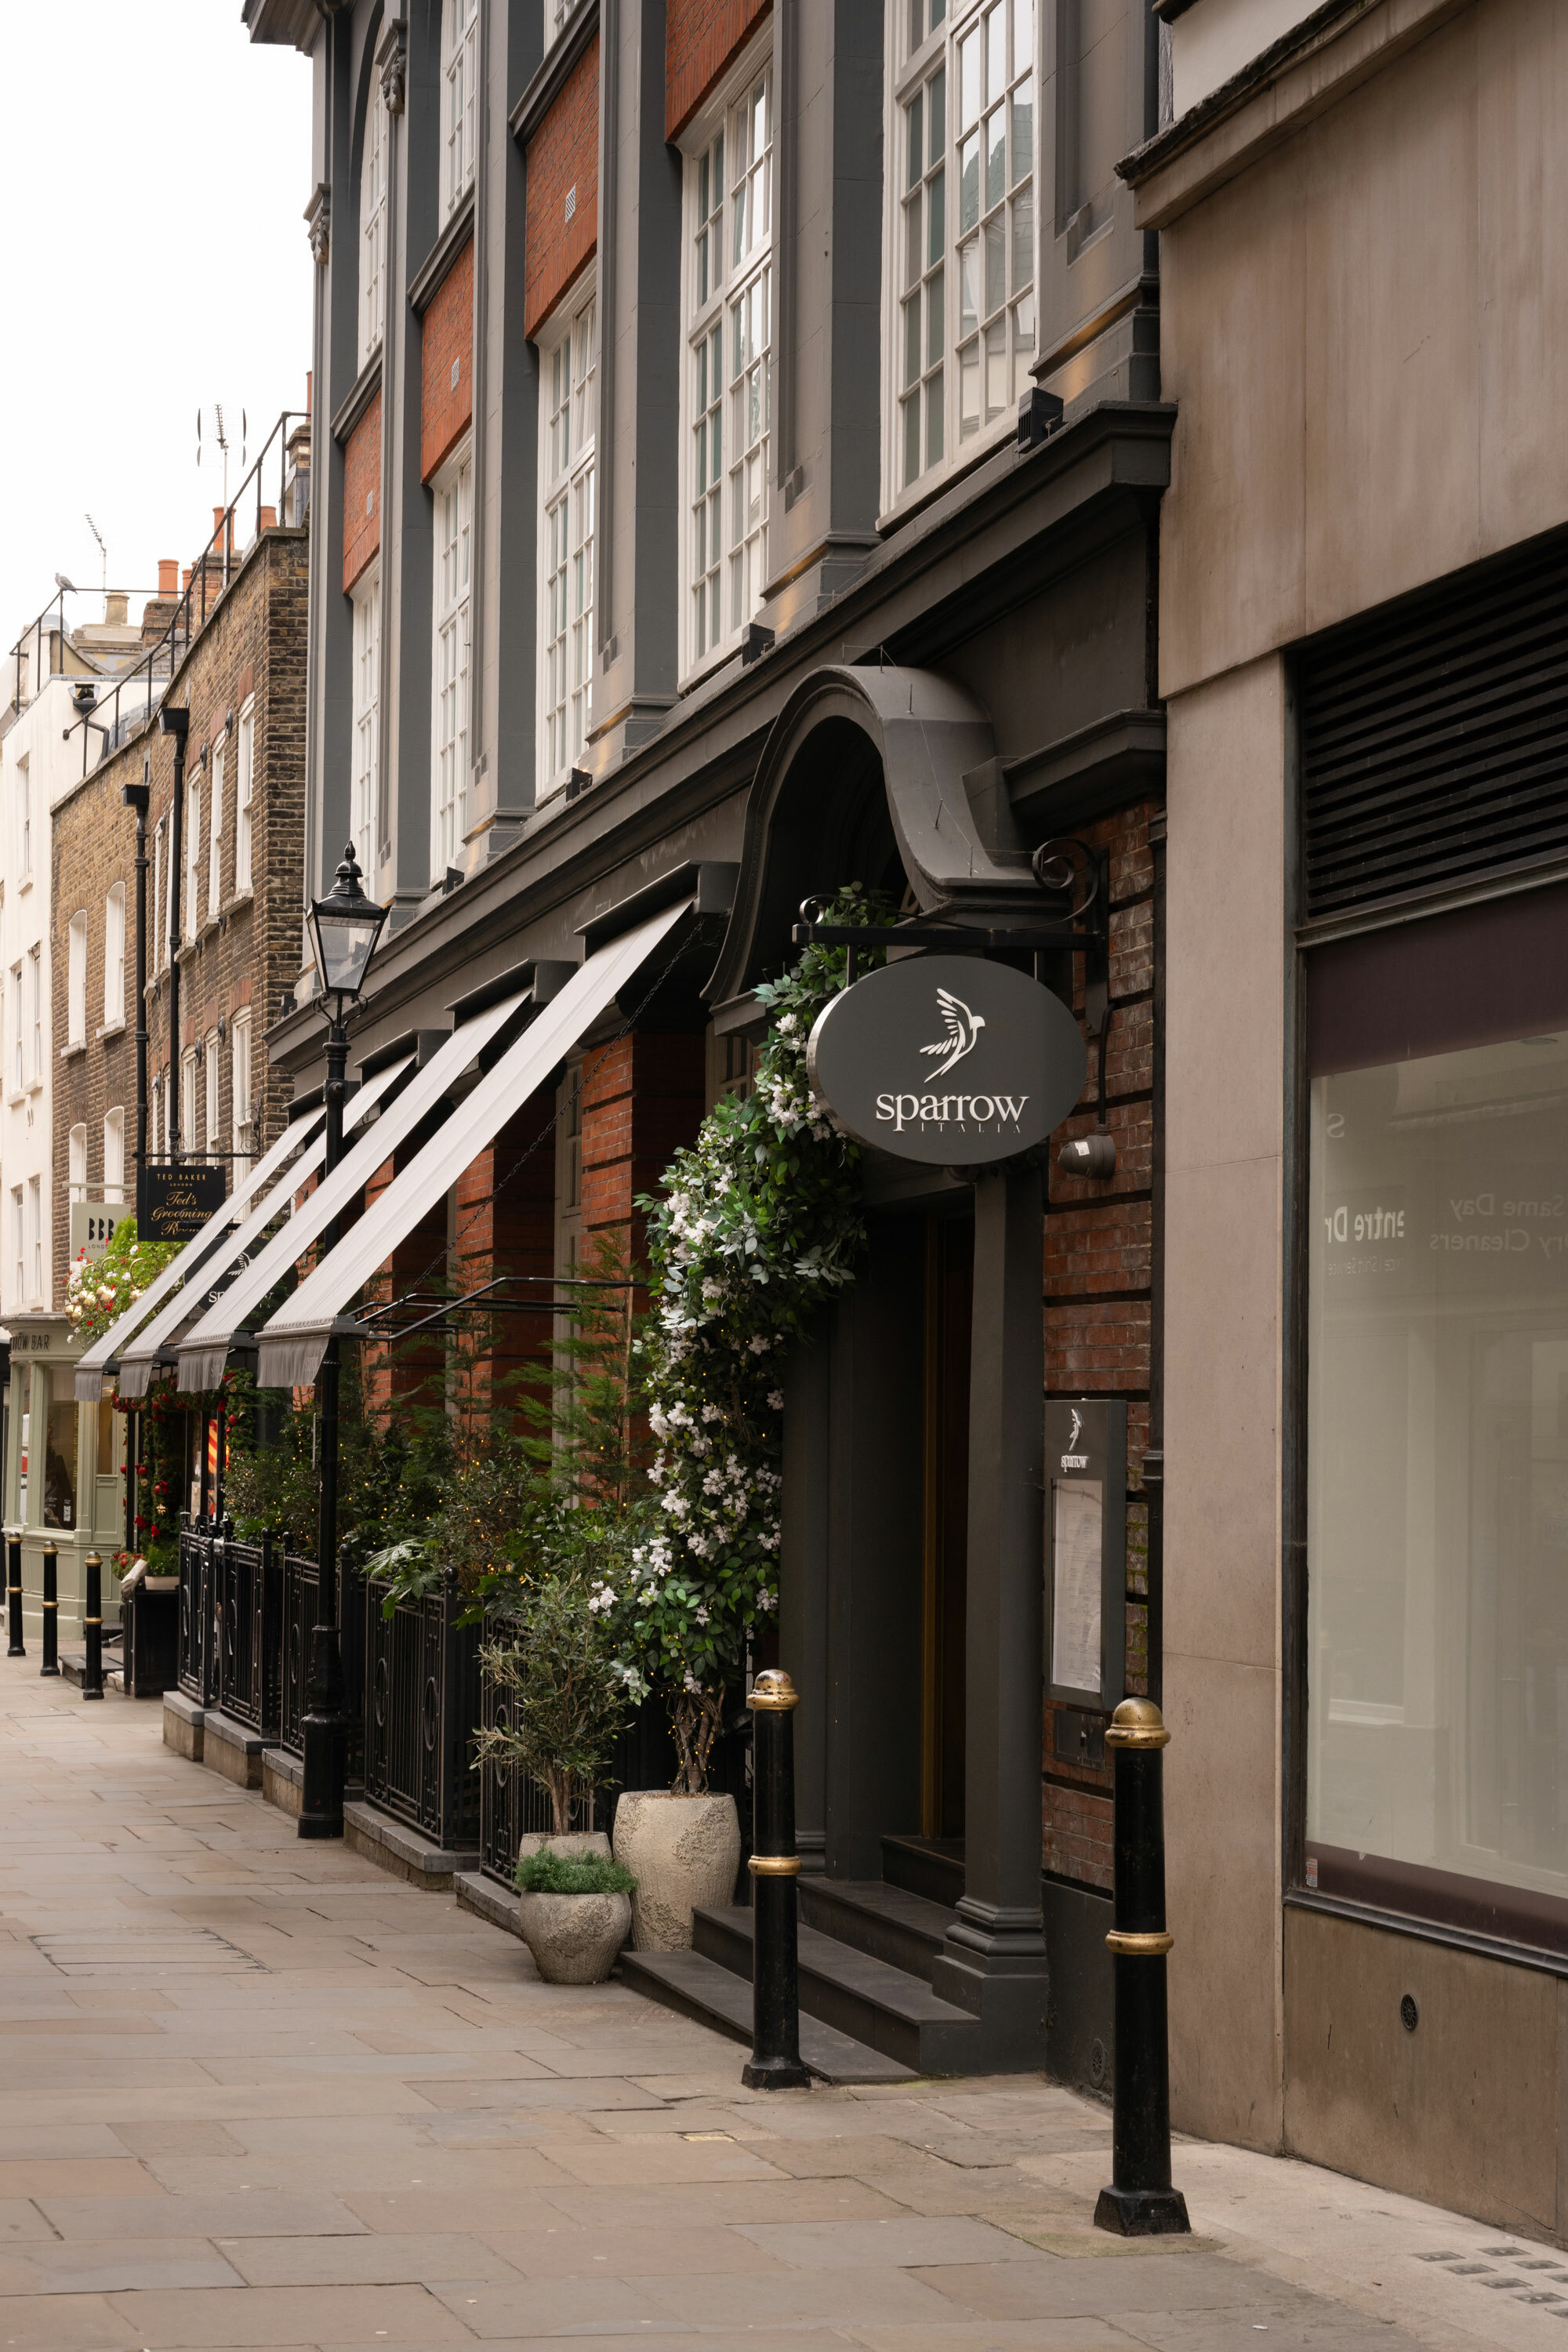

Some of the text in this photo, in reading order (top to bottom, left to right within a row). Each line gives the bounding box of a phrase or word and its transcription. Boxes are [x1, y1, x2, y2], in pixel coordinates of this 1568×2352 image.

[876, 1094, 1030, 1132] sparrow
[921, 1122, 1021, 1133] ITALIA
[165, 1191, 198, 1207] Ted's
[151, 1207, 213, 1223] Grooming
[89, 1218, 114, 1241] BBB
[31, 1334, 49, 1350] BAR
[1061, 1455, 1089, 1473] sparrow
